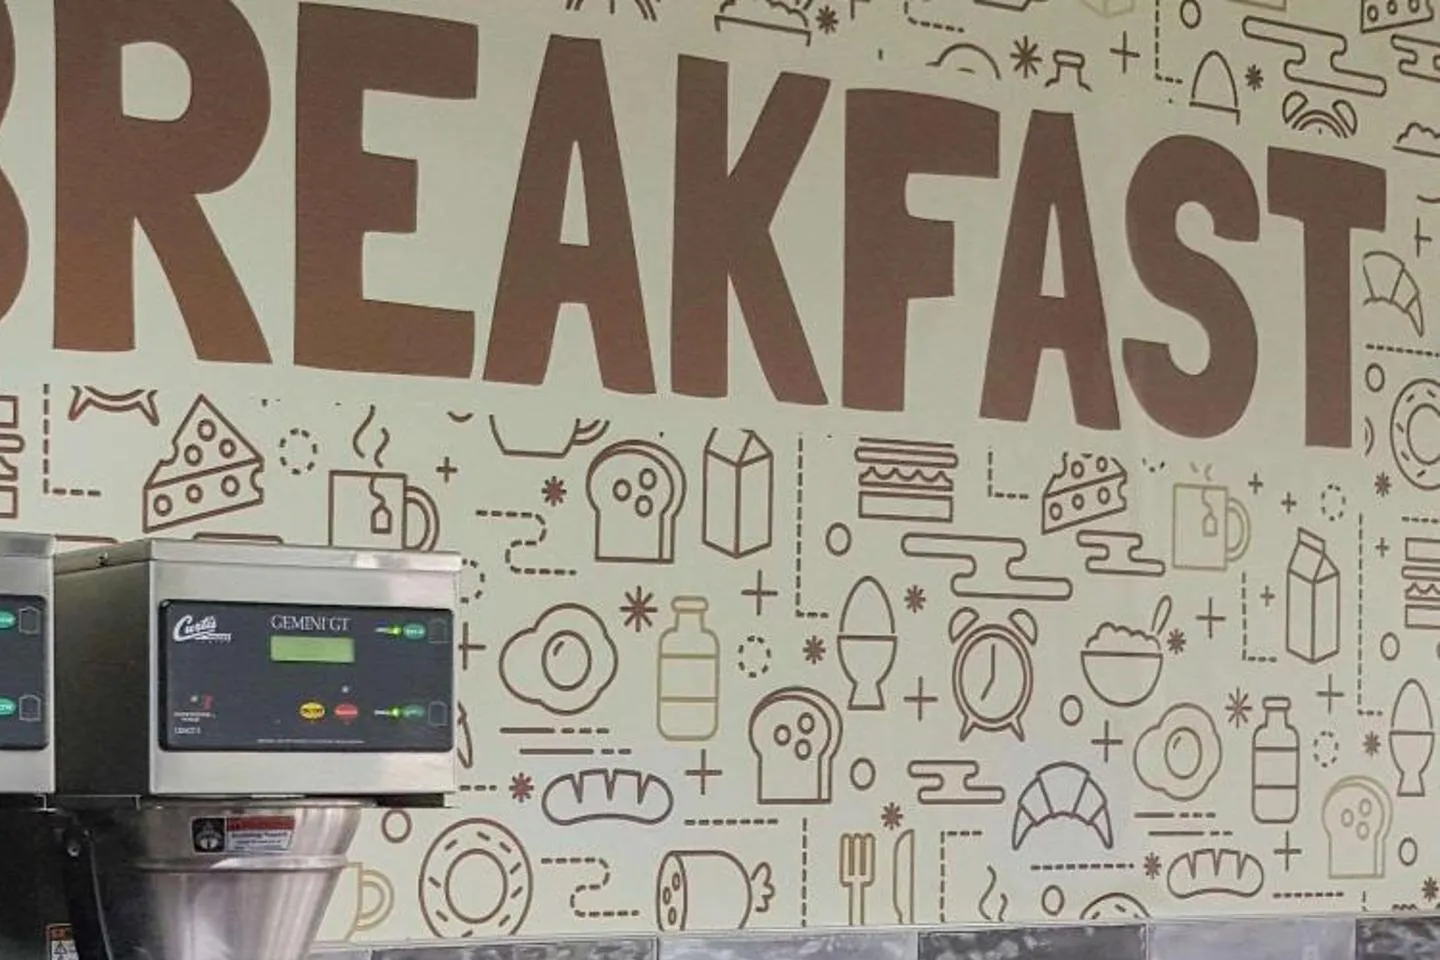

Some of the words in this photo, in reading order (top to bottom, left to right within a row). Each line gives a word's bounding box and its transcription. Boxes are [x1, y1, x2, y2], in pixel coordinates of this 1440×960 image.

[172, 613, 218, 641] Curtis
[271, 615, 326, 630] GEMINI
[329, 617, 352, 631] GT
